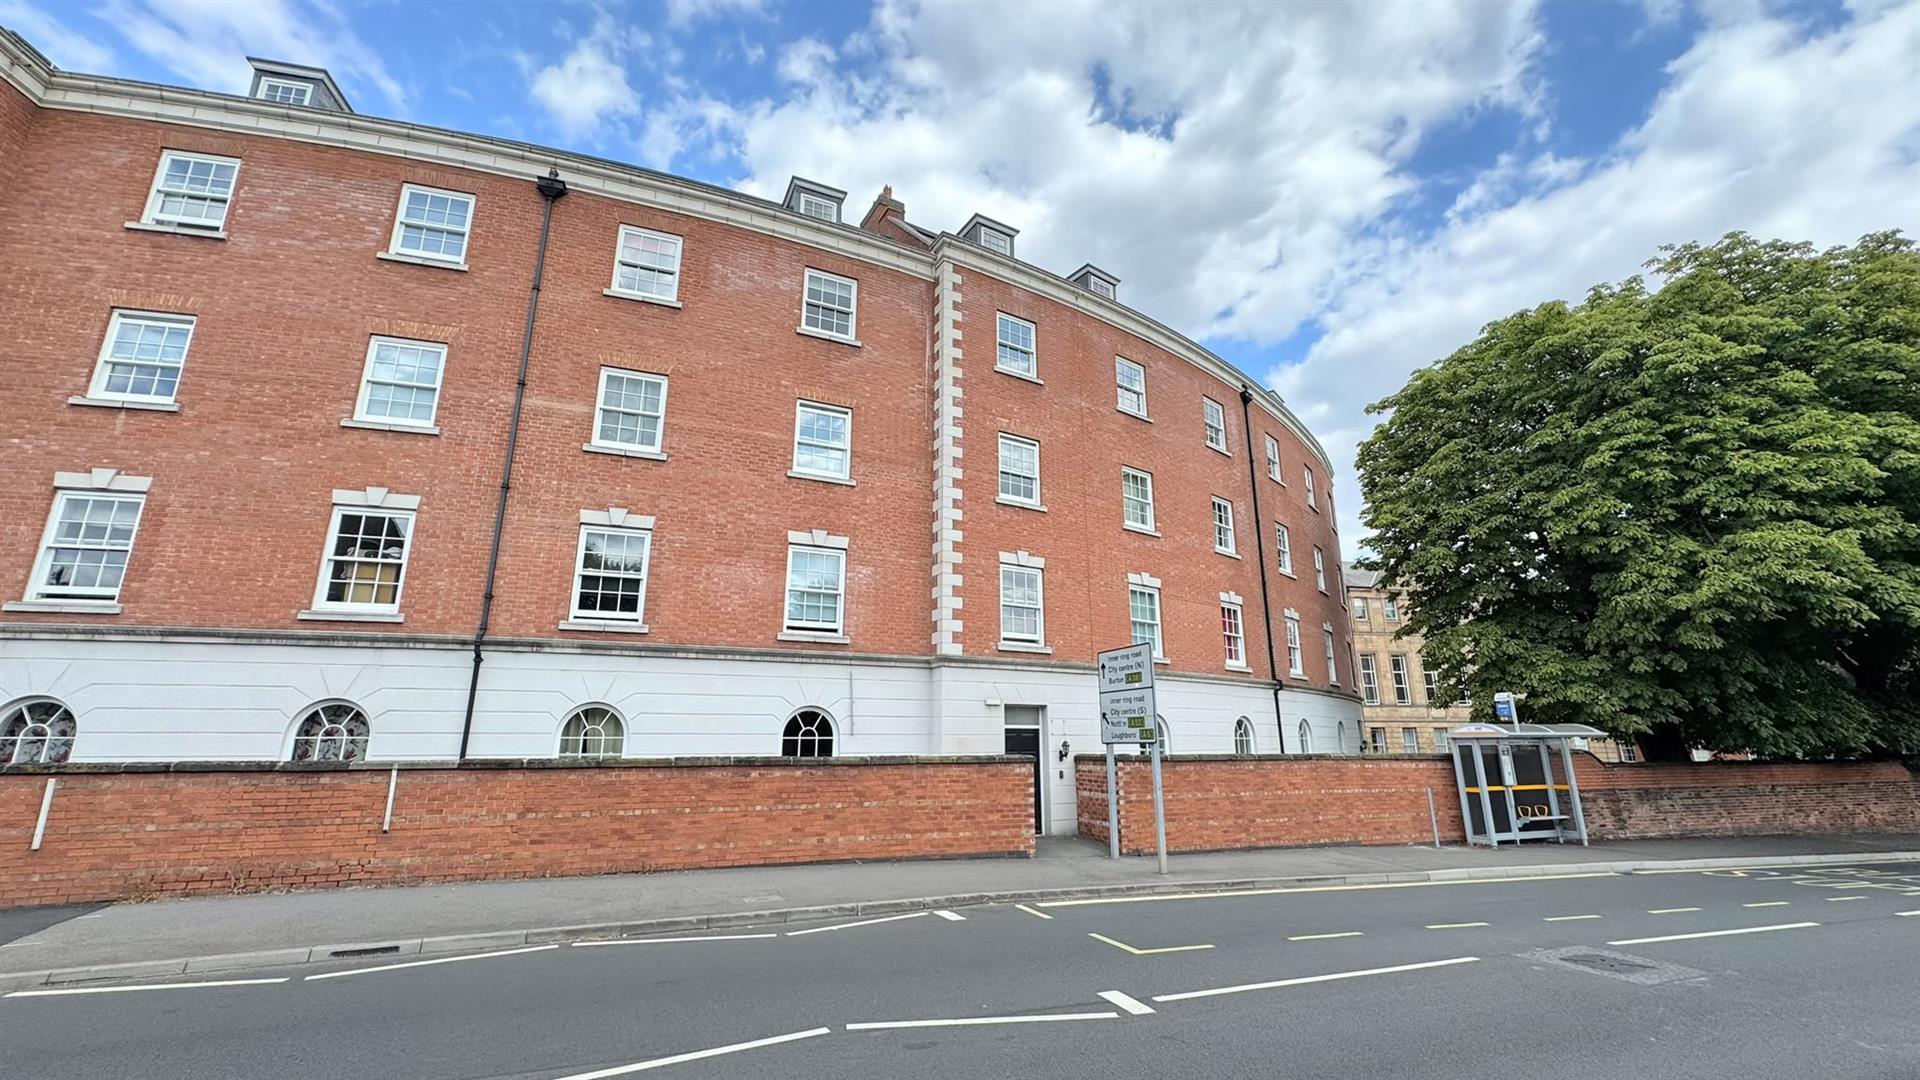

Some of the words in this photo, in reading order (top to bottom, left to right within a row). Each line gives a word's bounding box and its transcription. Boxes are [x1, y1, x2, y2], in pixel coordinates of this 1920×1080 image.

[1120, 653, 1129, 661] ring
[1130, 650, 1142, 658] road
[1108, 666, 1117, 674] City
[1118, 664, 1133, 672] centre
[1134, 660, 1144, 670] (N)
[1108, 677, 1124, 685] Burton
[1122, 696, 1132, 704] ring
[1110, 708, 1120, 717] City
[1121, 707, 1136, 715] centre
[1137, 706, 1147, 716] (S)
[1702, 869, 1920, 891] STOP
